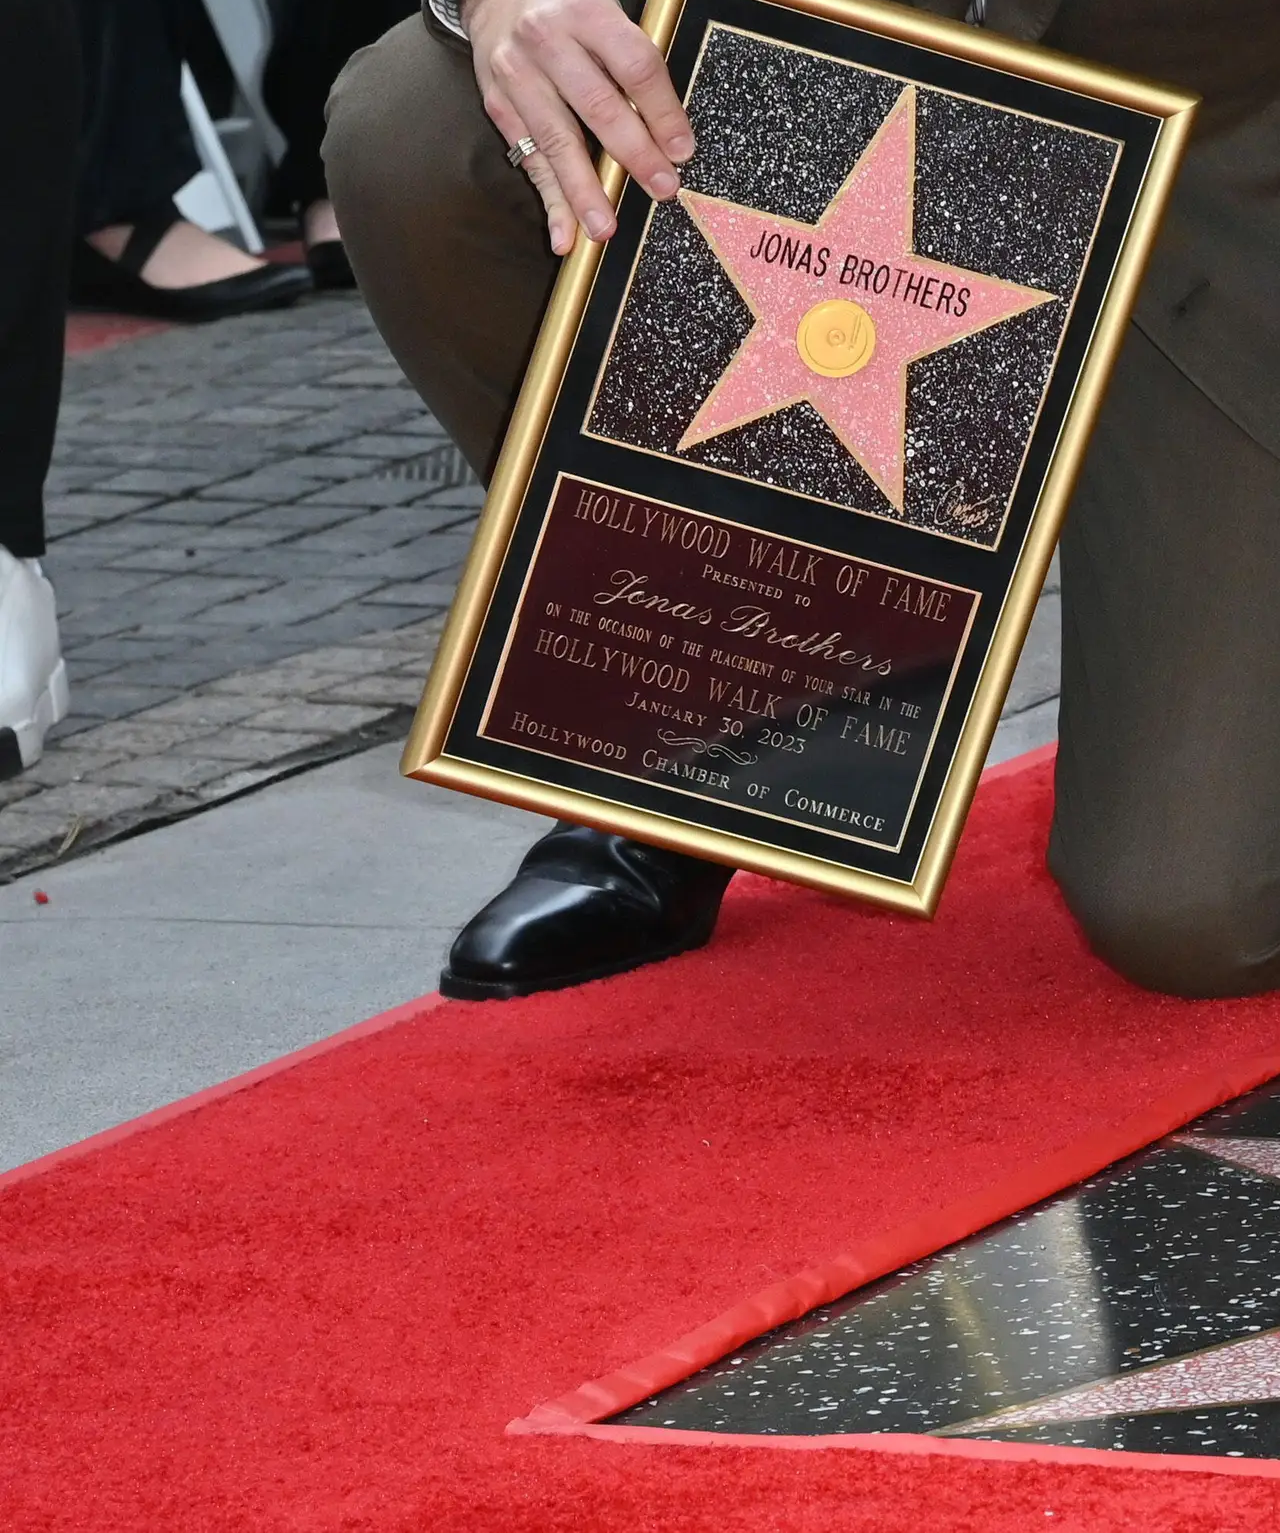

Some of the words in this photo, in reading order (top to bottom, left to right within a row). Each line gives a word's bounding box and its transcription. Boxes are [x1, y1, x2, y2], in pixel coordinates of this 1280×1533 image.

[751, 231, 830, 279] JONAS
[839, 254, 971, 318] BROTHERS
[574, 489, 731, 559] HOLLYWOOD
[748, 537, 824, 586] WALK
[836, 565, 870, 597] OF
[879, 576, 951, 622] FAME
[546, 602, 562, 617] ON
[569, 608, 592, 626] THE
[598, 617, 653, 643] OCCASION
[659, 634, 675, 649] OF
[681, 640, 704, 658] THE
[710, 648, 775, 678] PLACEMENT
[781, 669, 797, 684] OF
[804, 675, 834, 696] YOUR
[841, 685, 871, 706] STAR
[879, 696, 893, 711] IN
[900, 701, 922, 719] THE
[593, 569, 712, 625] Jonas
[719, 605, 892, 676] Brothers
[534, 628, 690, 693] HOLLYWOOD
[707, 677, 783, 720] WALK
[796, 703, 829, 732] OF
[840, 716, 911, 756] FAME
[757, 728, 807, 754] 2023
